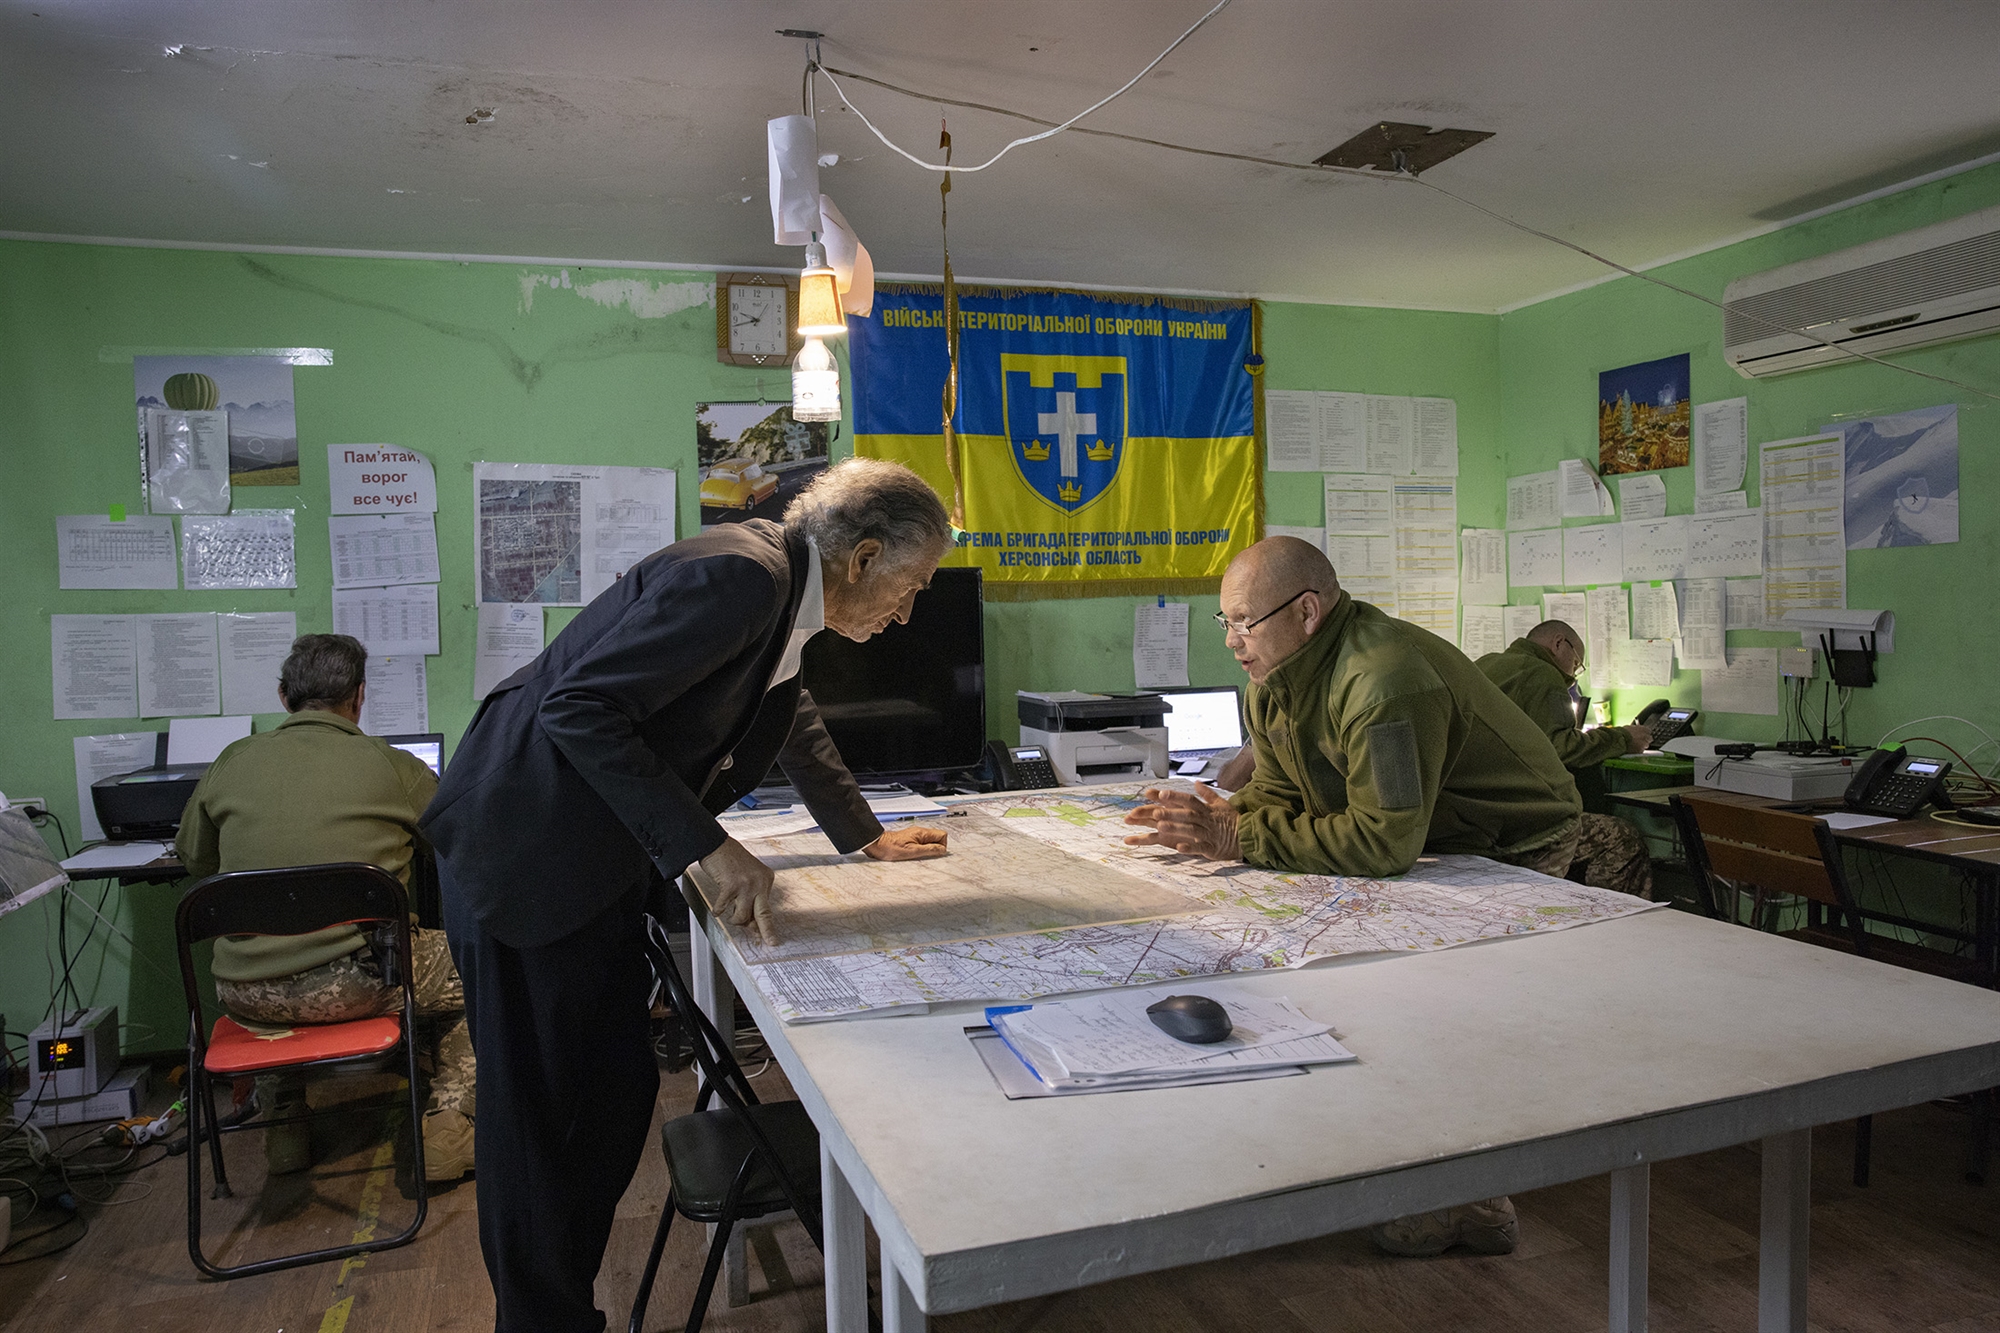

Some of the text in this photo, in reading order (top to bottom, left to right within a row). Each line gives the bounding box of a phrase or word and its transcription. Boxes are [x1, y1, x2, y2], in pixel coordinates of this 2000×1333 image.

[738, 289, 745, 298] 11
[753, 289, 761, 298] 12
[770, 290, 774, 299] 1
[732, 302, 739, 311] 10
[776, 304, 782, 313] 2
[733, 316, 738, 324] 9
[776, 317, 782, 326] 3
[883, 306, 1227, 340] ВІЙСЬК ТЕРИТОРІАЛЬНОЇ ОБОРОНИ УКРАЇНИ
[733, 329, 739, 337] 8
[740, 343, 745, 351] 7
[755, 343, 761, 352] 6
[770, 344, 776, 352] 5
[344, 450, 421, 464] Пам’ятай,
[362, 473, 408, 486] ворог
[353, 491, 418, 507] все чує!
[1175, 528, 1230, 546] ОБОРОНИ
[1085, 550, 1142, 566] ОБЛАСТЬ
